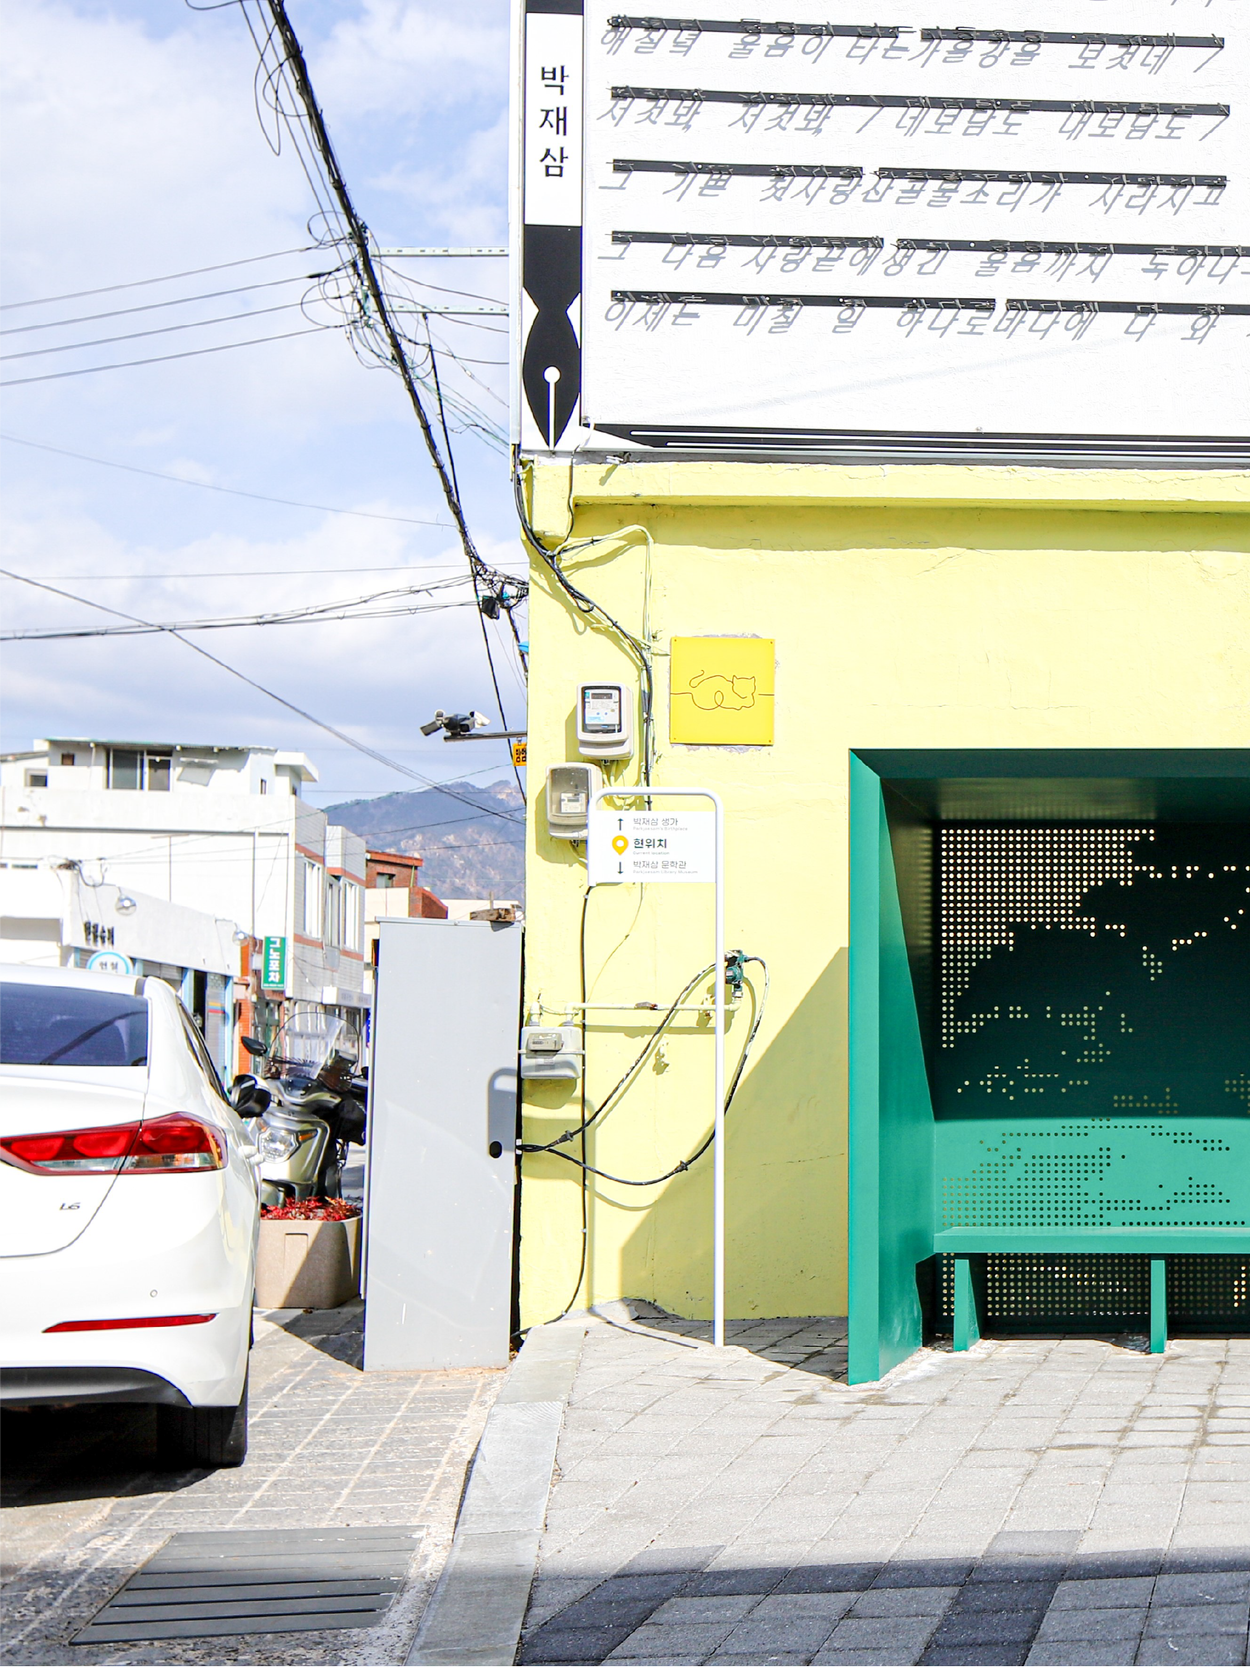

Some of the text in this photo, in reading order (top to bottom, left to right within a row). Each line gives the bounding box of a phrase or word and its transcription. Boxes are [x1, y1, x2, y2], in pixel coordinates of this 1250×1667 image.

[728, 25, 834, 64] 울음이
[1068, 37, 1176, 75] 보것네
[538, 64, 569, 179] 박재삼
[896, 101, 1030, 137] 네보담도
[1059, 106, 1192, 141] 내보담도
[598, 163, 634, 190] 그
[662, 167, 733, 202] 기쁜
[1088, 175, 1227, 217] 사라지고
[597, 235, 632, 260] 그
[662, 238, 730, 271] 다음
[974, 244, 1115, 283] 울음까지
[604, 295, 702, 332] 이제는
[733, 299, 804, 336] 미칠
[832, 301, 867, 334] 일
[1124, 306, 1160, 342] 다
[1181, 308, 1221, 344] 와
[633, 817, 679, 826] 박재삼 생가
[633, 838, 667, 849] 현위치
[633, 860, 687, 869] 박재삼 문학관
[268, 937, 281, 983] 그노포차
